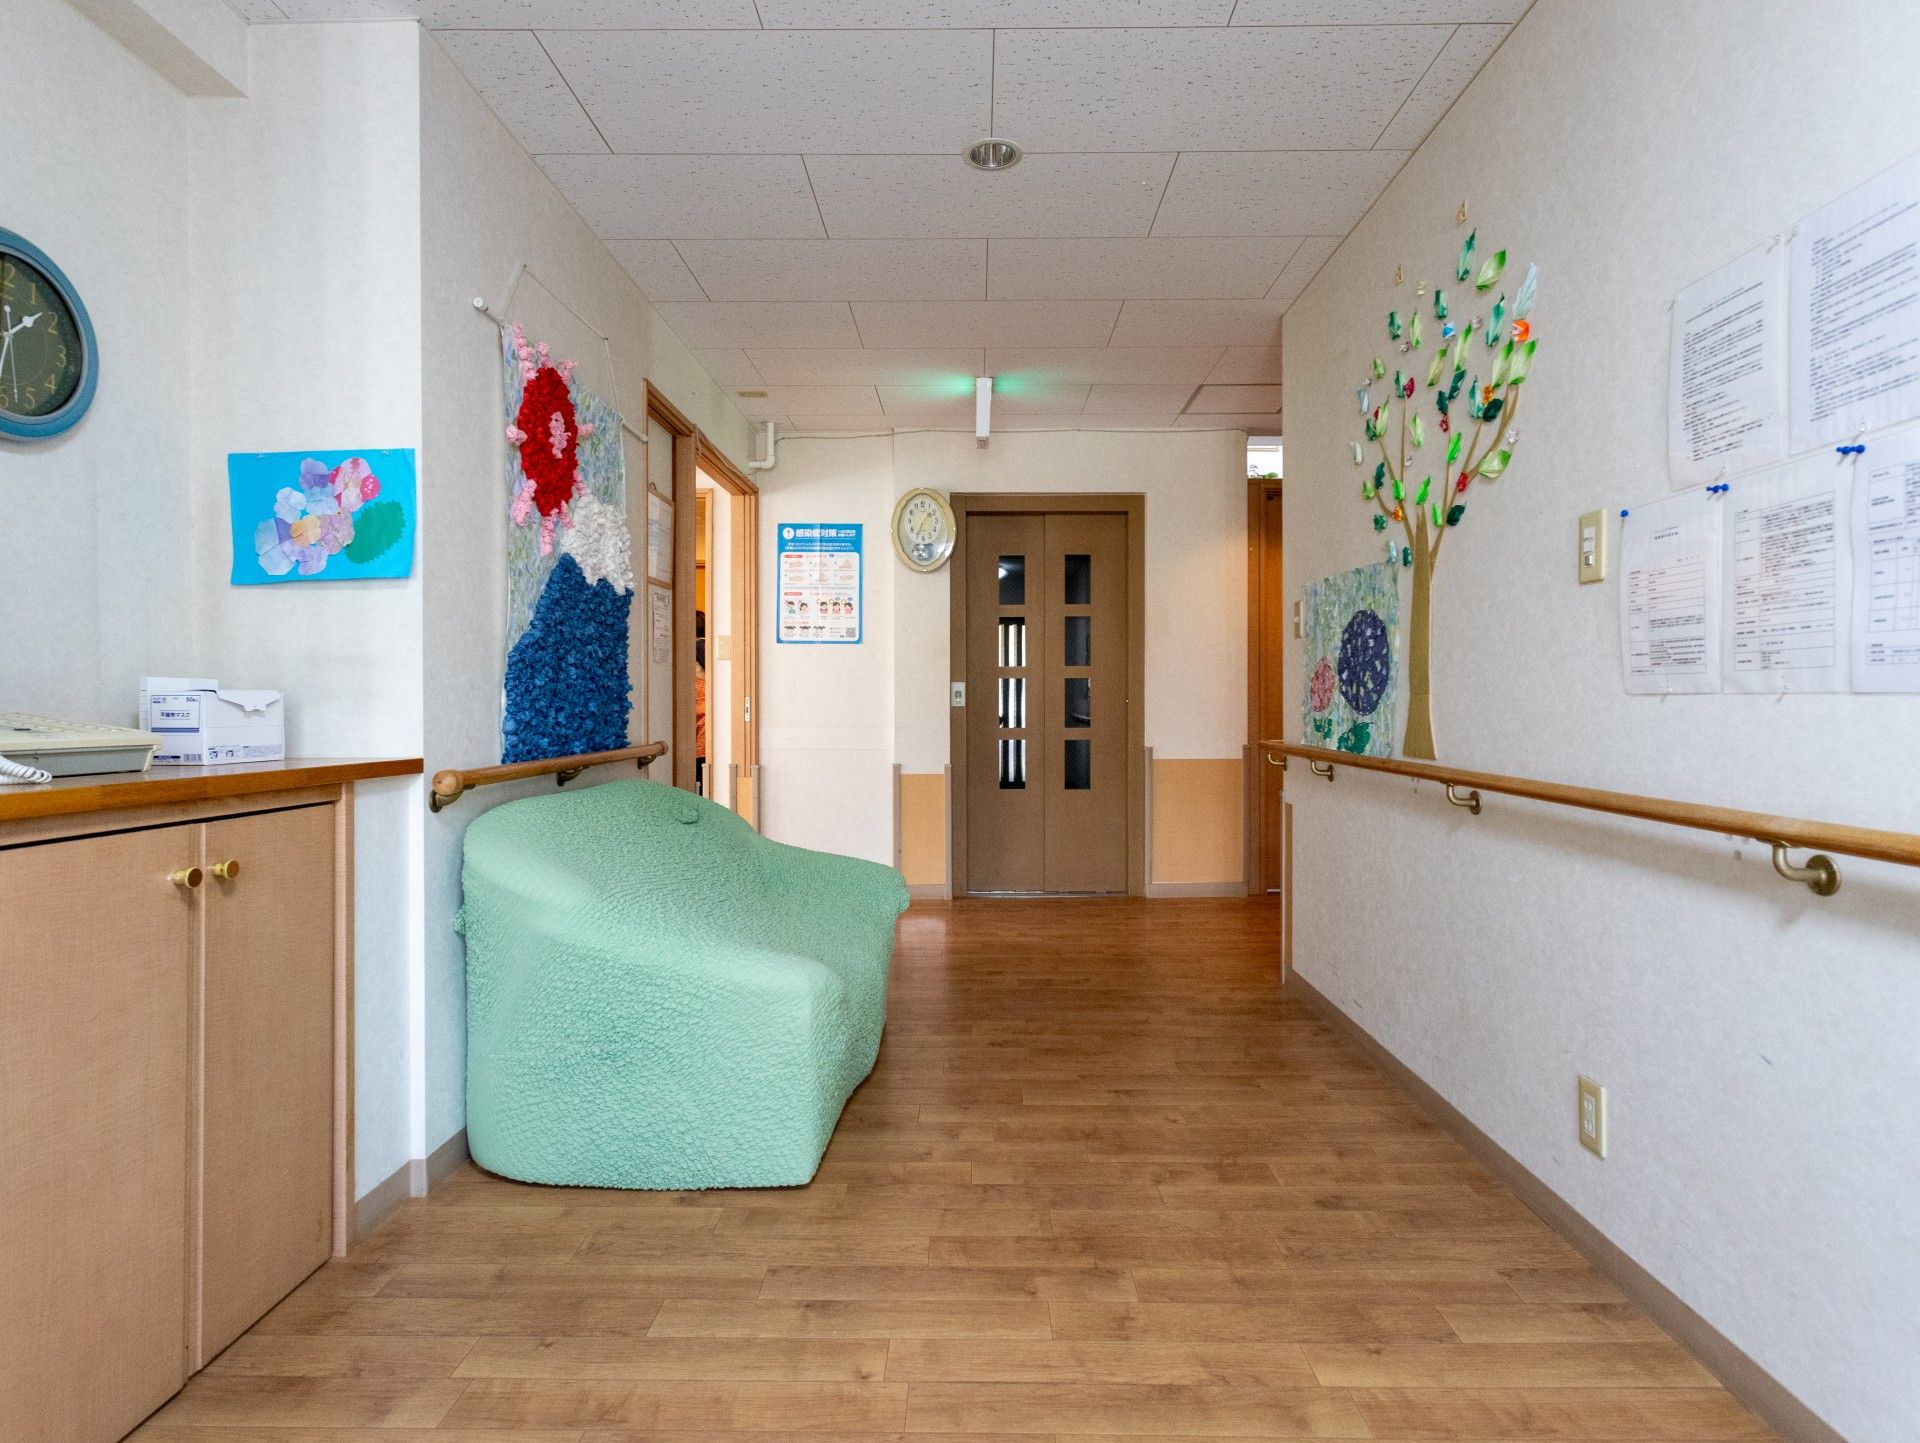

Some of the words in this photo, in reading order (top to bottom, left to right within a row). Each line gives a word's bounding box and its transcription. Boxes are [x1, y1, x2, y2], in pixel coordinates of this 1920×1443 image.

[30, 282, 37, 305] 1
[47, 311, 59, 335] 2
[56, 344, 67, 368] 3
[44, 373, 57, 395] 4
[24, 386, 36, 411] 5
